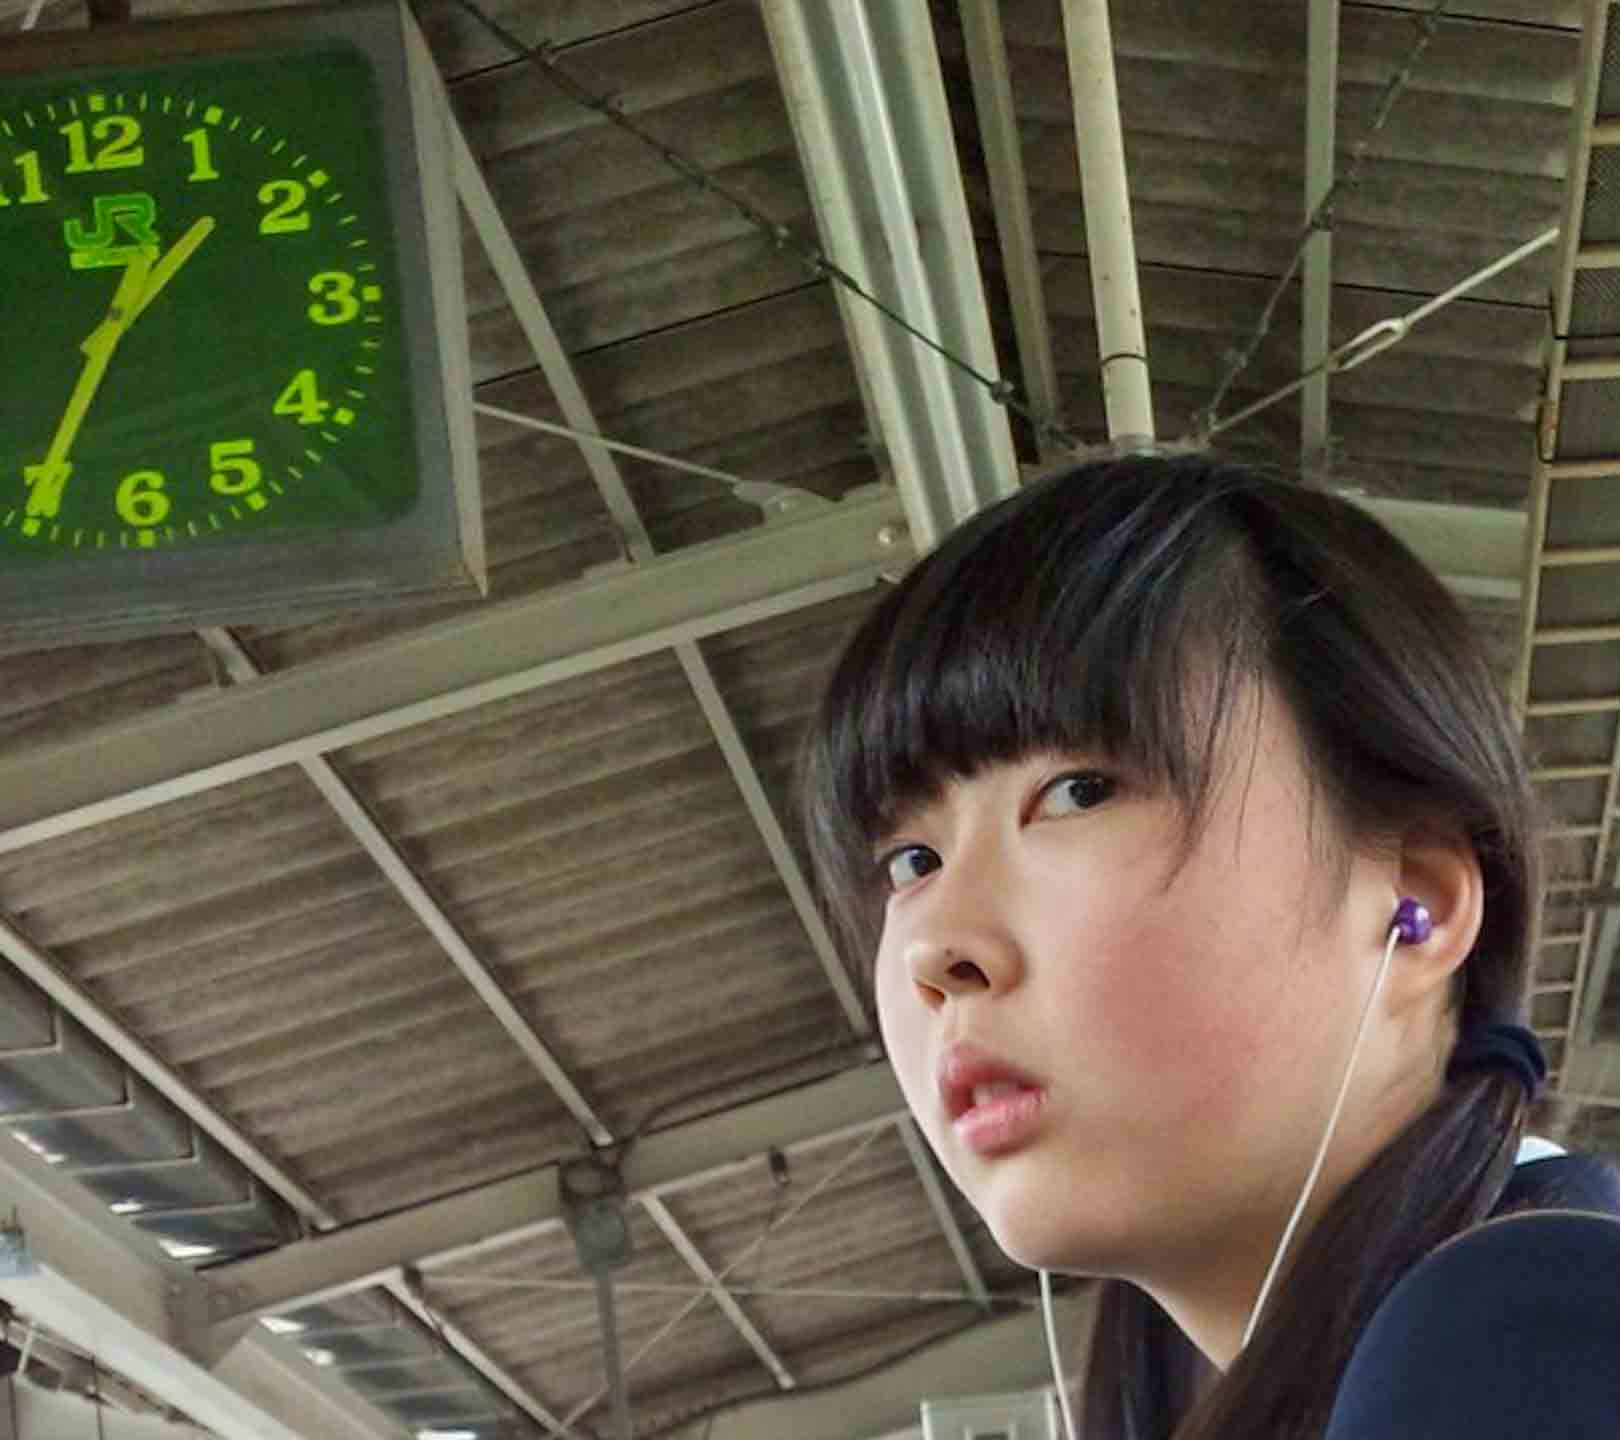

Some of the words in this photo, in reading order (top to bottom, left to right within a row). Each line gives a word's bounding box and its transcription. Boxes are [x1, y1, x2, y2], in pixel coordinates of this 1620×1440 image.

[60, 115, 145, 173] 12
[183, 128, 219, 182] 1
[0, 150, 49, 206] 1
[63, 192, 161, 249] JR
[257, 178, 311, 235] 2
[307, 271, 360, 325] 3
[272, 368, 329, 425] 4
[209, 440, 262, 494] 5
[115, 470, 171, 525] 6
